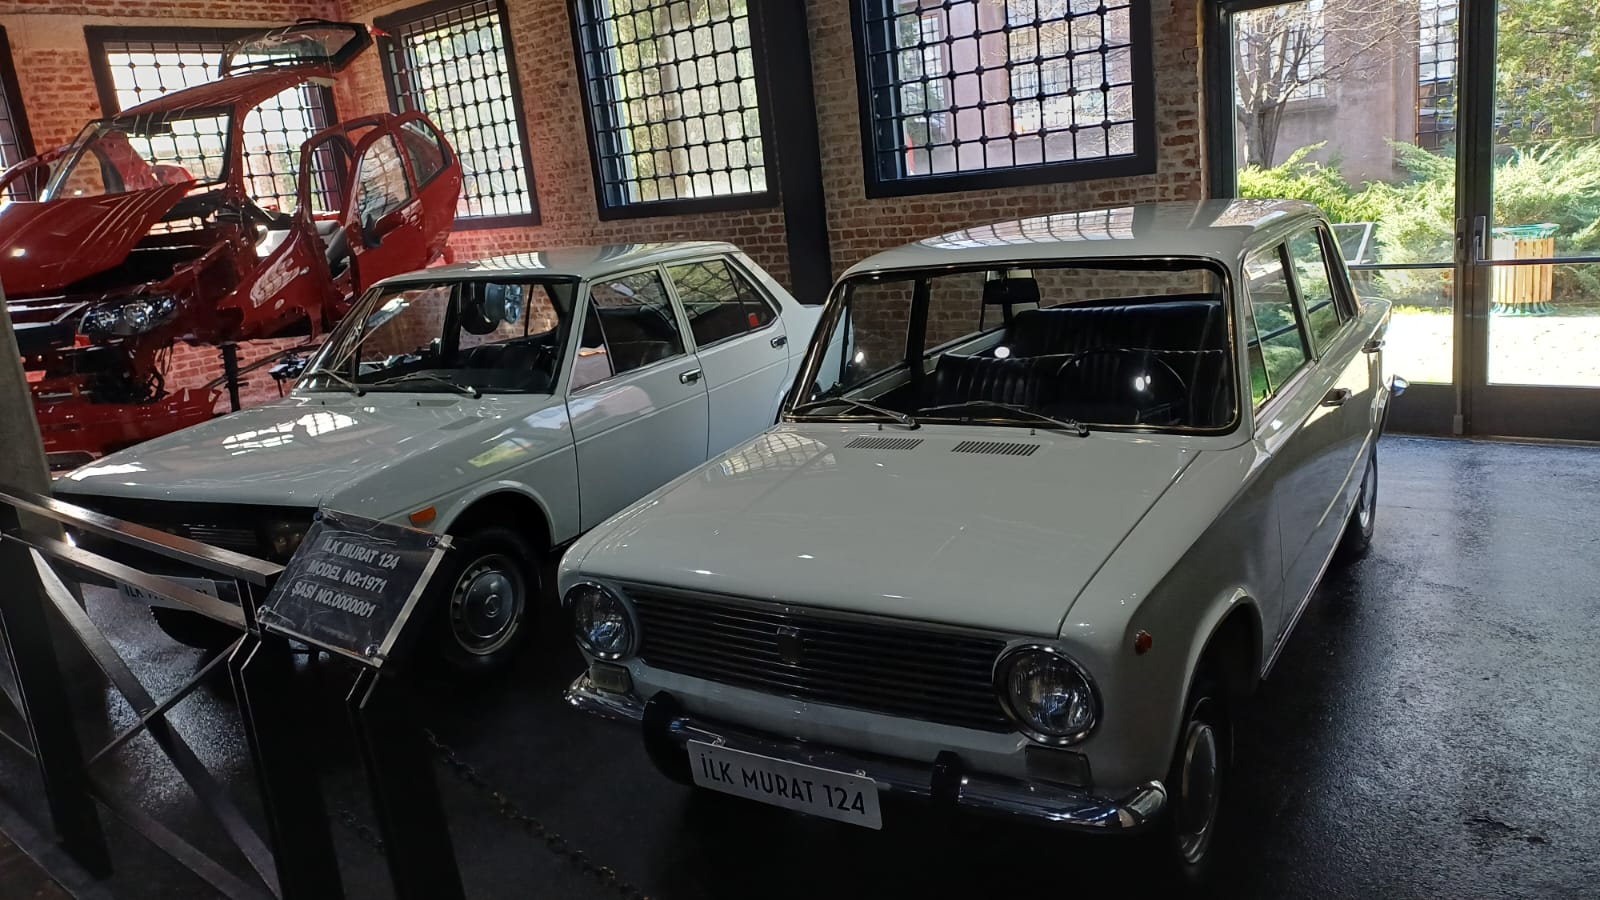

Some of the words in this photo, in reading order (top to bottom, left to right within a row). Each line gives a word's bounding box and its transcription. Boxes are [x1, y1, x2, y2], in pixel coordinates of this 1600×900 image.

[321, 536, 342, 553] İLK
[340, 543, 379, 563] MURAT
[378, 553, 400, 569] 124
[307, 560, 341, 580] MODEL
[701, 753, 734, 784] İLK
[742, 768, 813, 803] MURAT
[823, 785, 865, 814] 124
